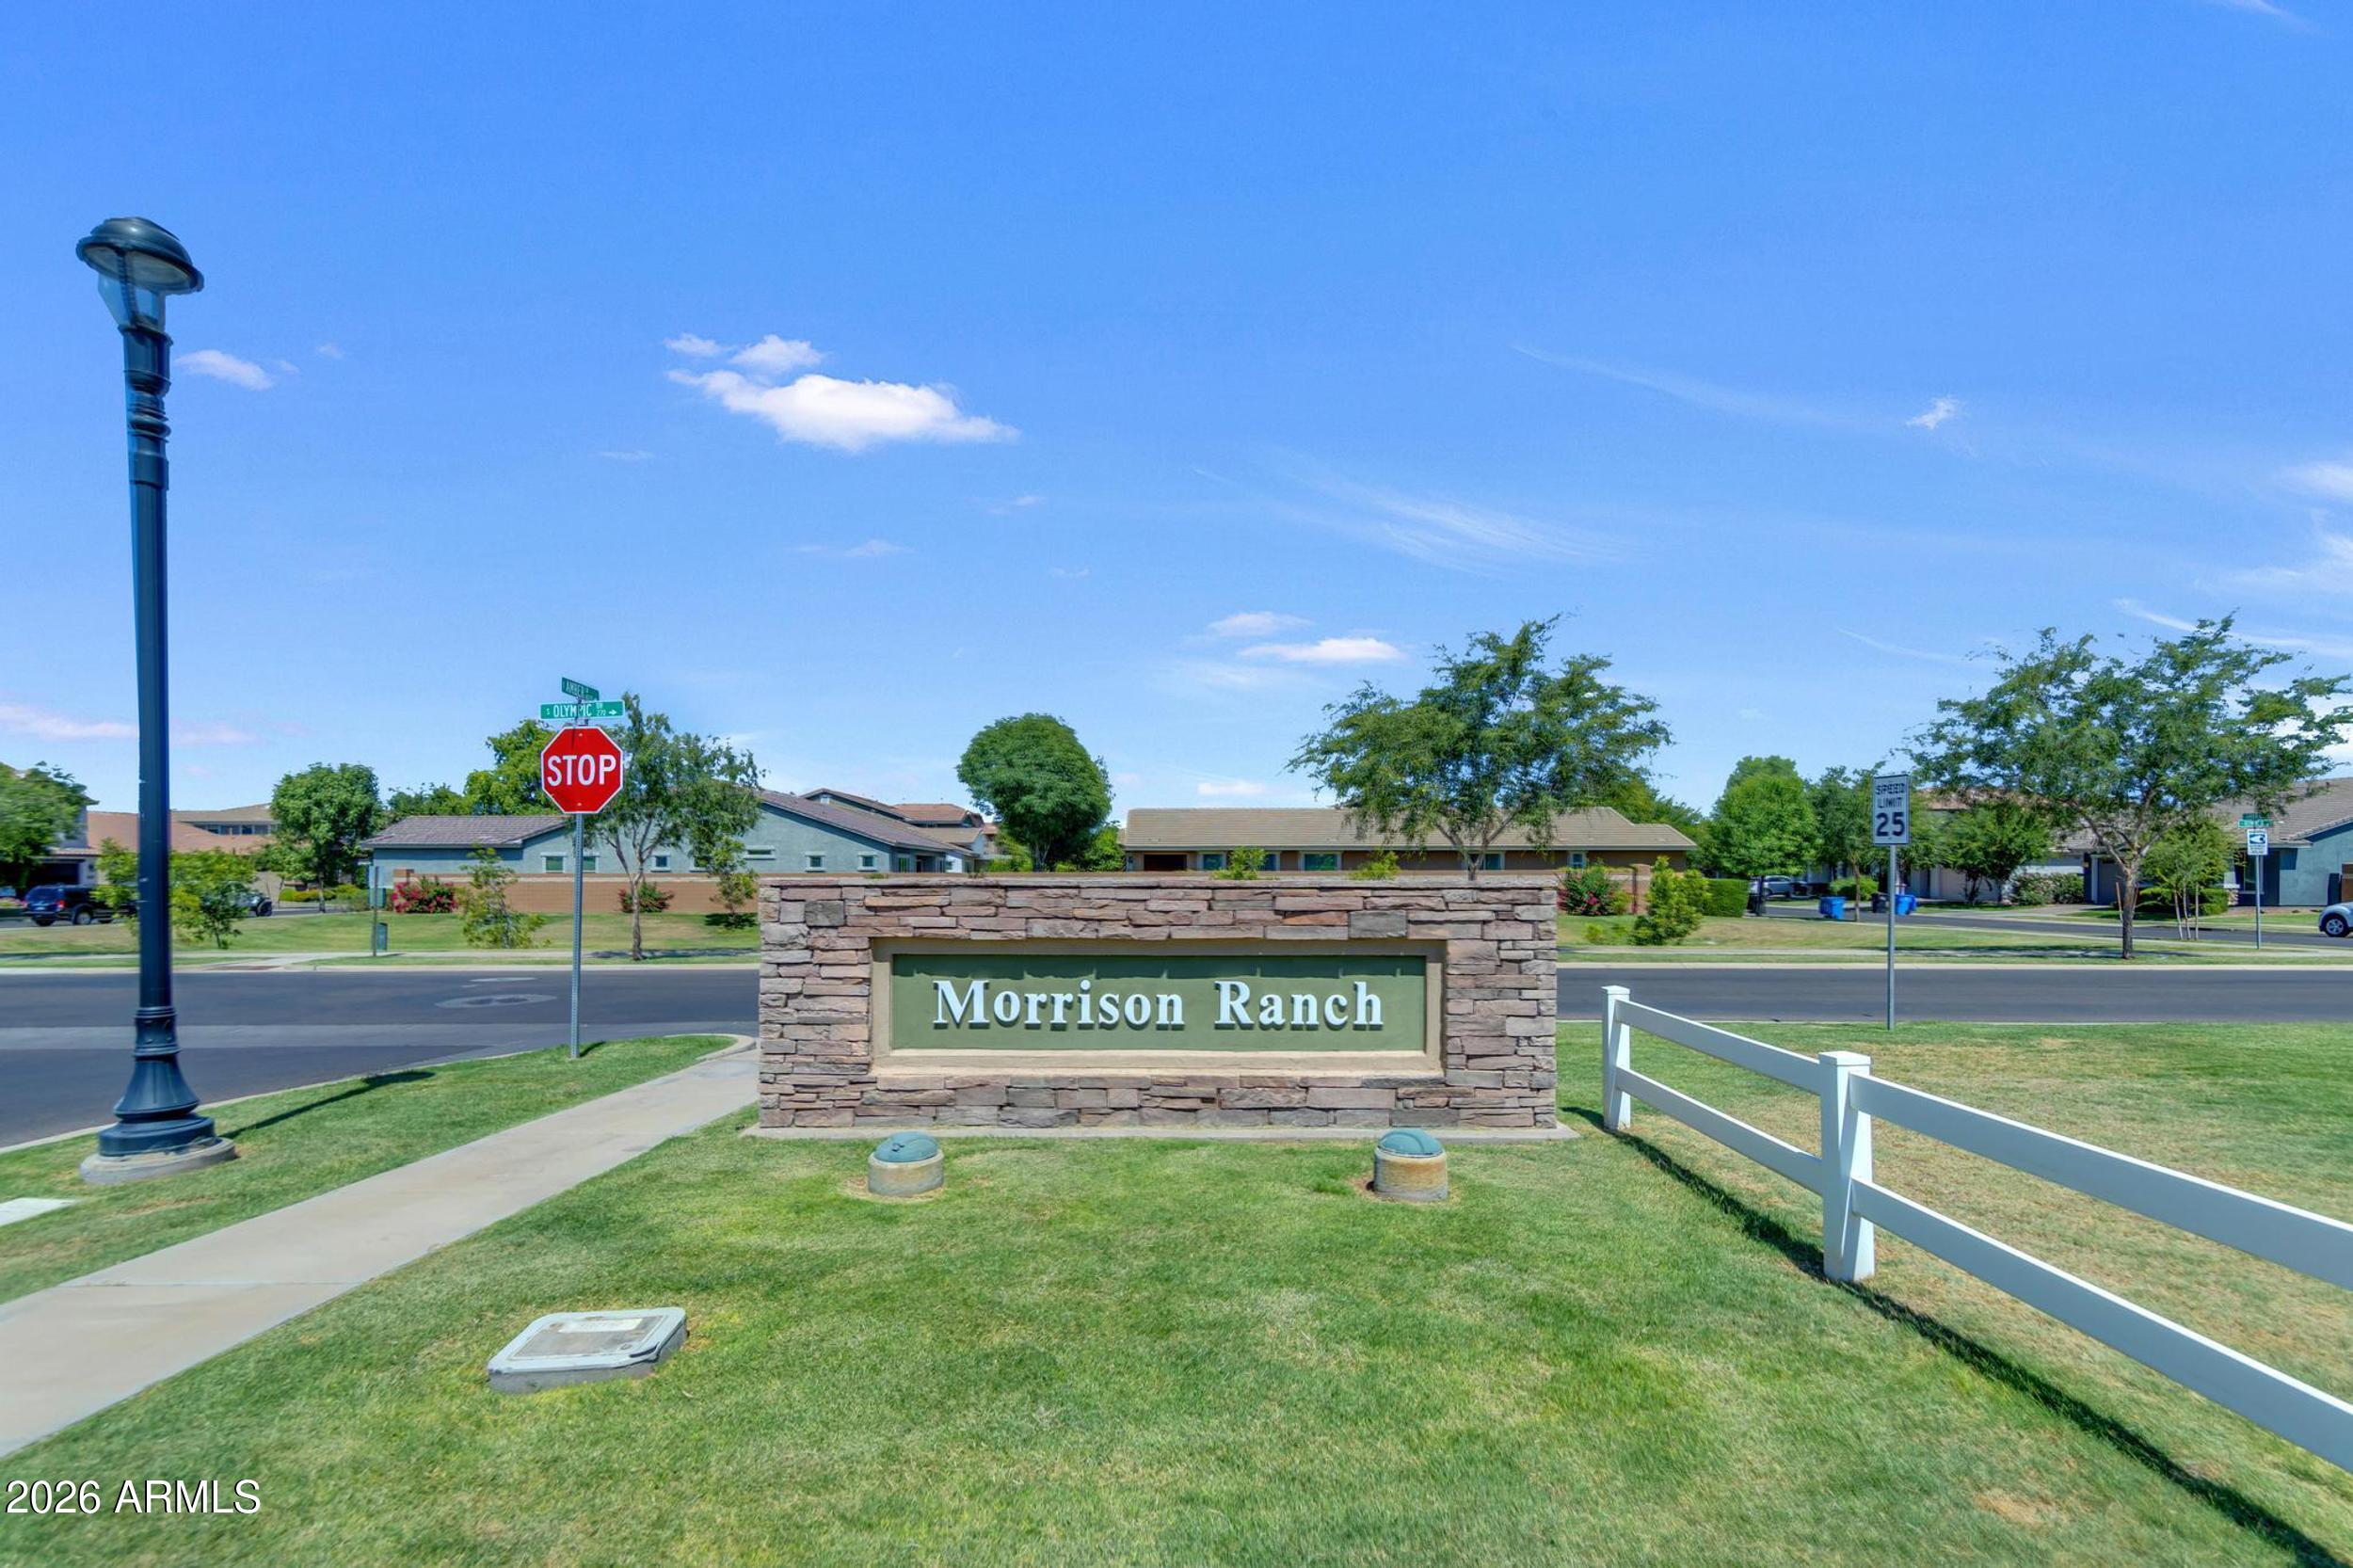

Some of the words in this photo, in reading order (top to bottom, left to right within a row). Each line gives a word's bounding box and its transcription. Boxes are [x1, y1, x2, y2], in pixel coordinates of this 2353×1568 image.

[553, 704, 592, 717] OLYMPIC
[547, 754, 616, 786] STOP
[1875, 782, 1906, 795] SPEED
[1877, 796, 1904, 808] LIMIT
[1876, 811, 1906, 837] 25
[933, 978, 1186, 1029] Morrison
[1213, 980, 1385, 1030] Ranch
